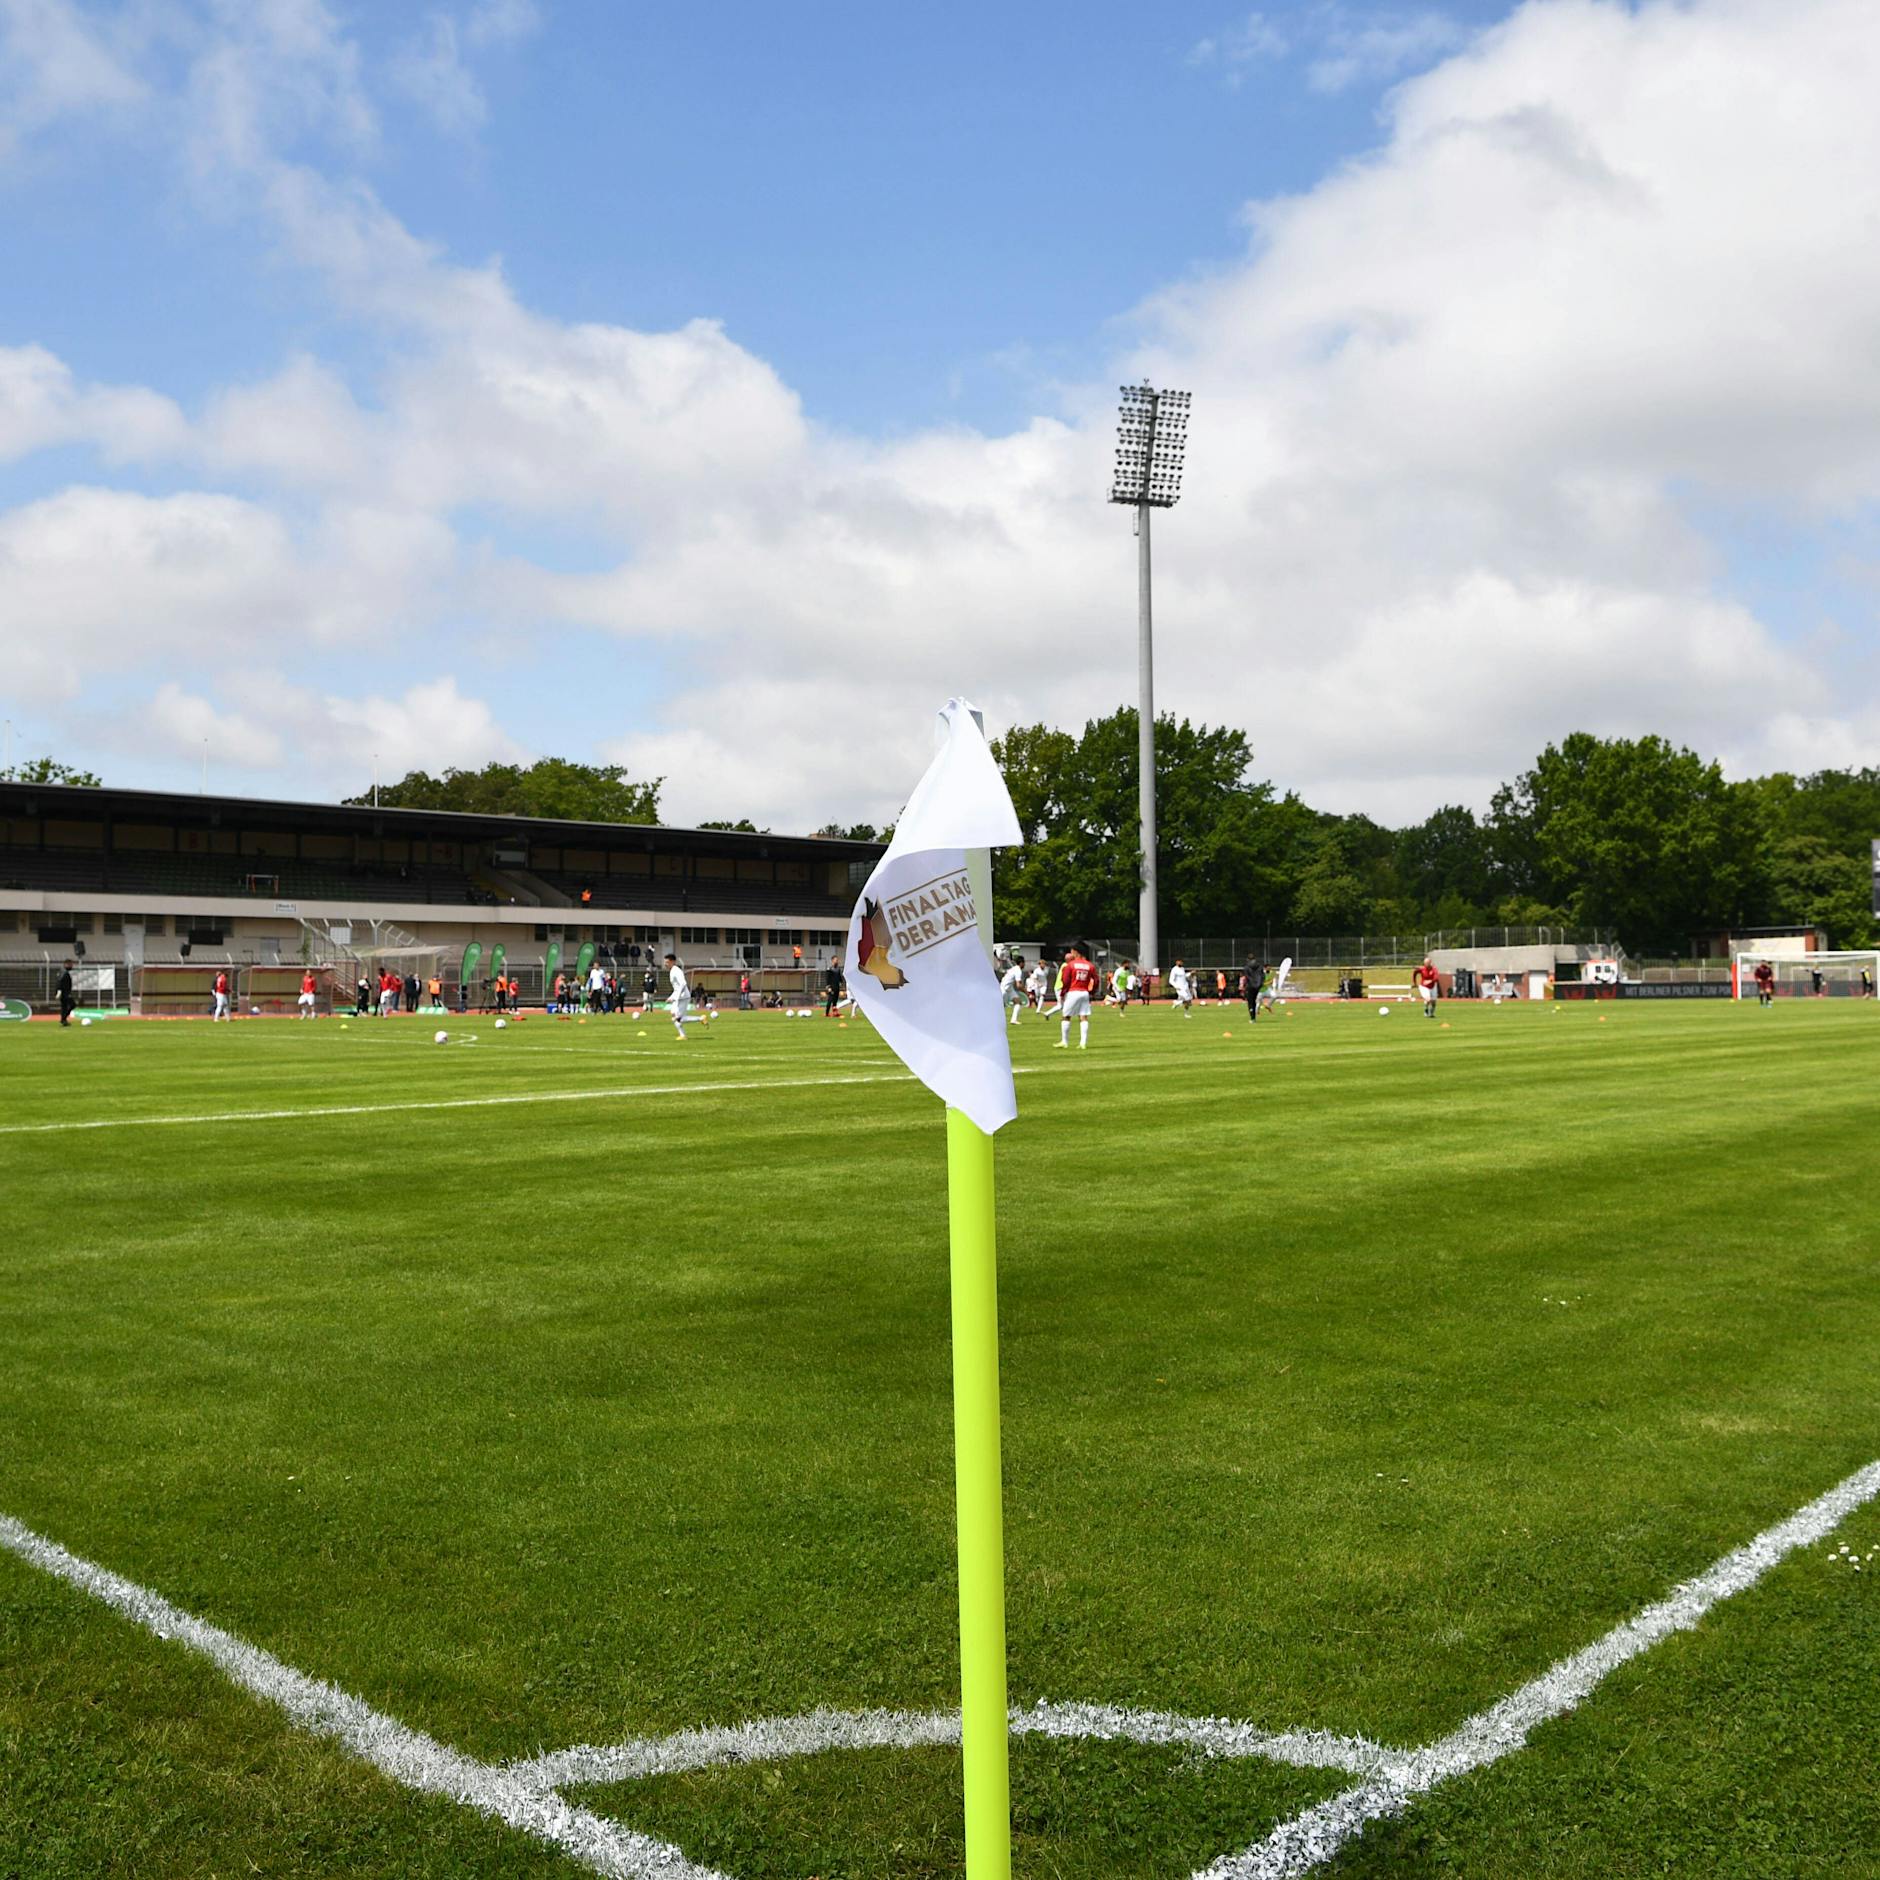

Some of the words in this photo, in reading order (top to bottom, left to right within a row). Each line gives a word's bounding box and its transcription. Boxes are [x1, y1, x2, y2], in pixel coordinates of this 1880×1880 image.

[888, 876, 972, 929] FINALTAG
[896, 919, 939, 952] DER
[943, 899, 977, 932] AMA
